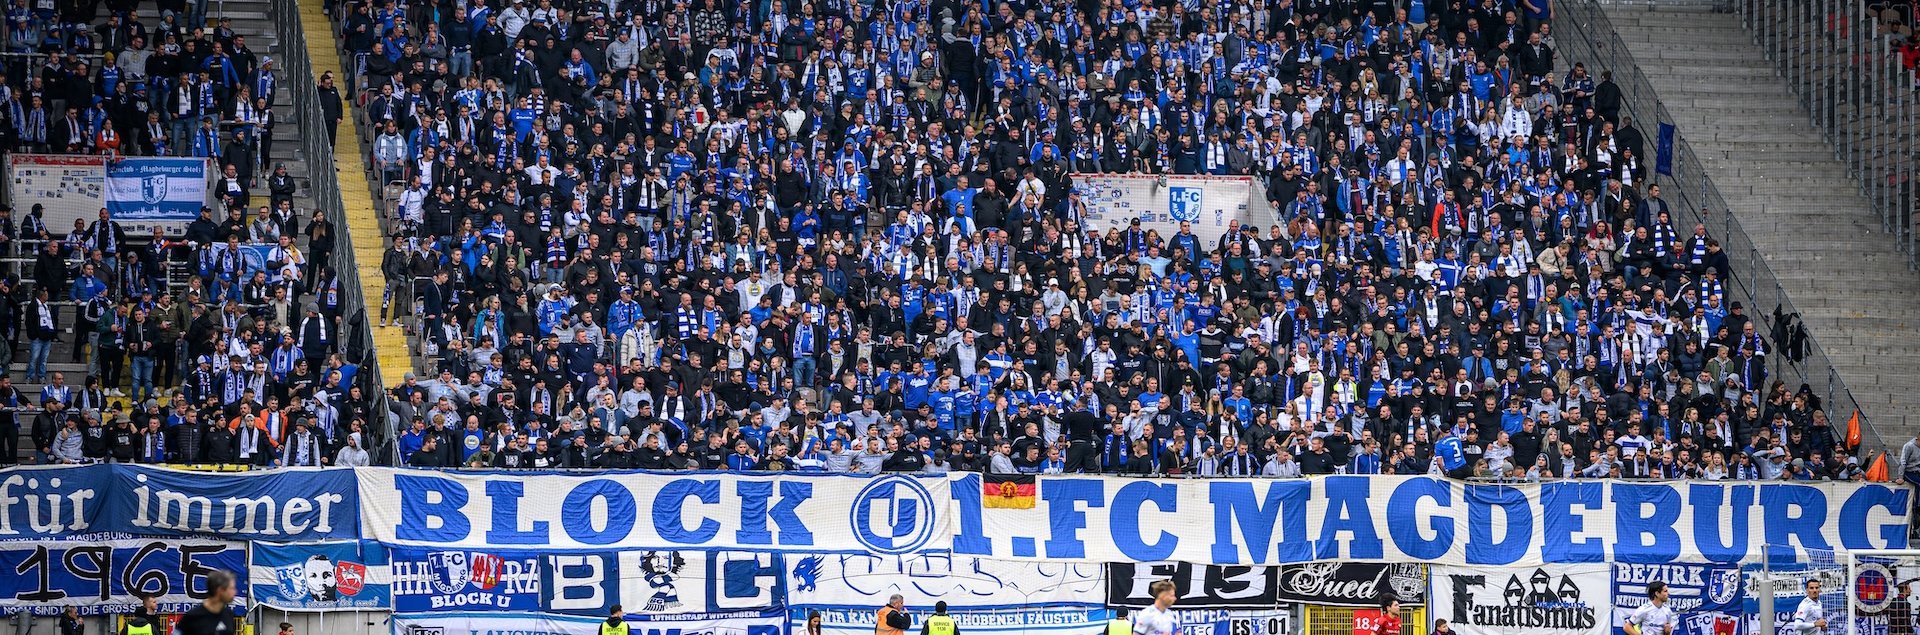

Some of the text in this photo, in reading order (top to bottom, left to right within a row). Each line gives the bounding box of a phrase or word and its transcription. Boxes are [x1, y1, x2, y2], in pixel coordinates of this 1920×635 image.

[1171, 191, 1200, 202] 1.FC
[0, 474, 342, 536] für immer
[395, 474, 814, 546] BLOCK
[951, 473, 1910, 565] 1.FC MAGDEBURG
[432, 569, 467, 594] MAGDEBURG
[1616, 563, 1705, 587] BEZIRK
[35, 606, 59, 615] SIND
[82, 605, 99, 615] DIE
[161, 602, 182, 613] AUF
[431, 592, 512, 608] BLOCK U
[1449, 574, 1596, 631] Fanatismus
[650, 612, 708, 622] LUTHERSTADT
[1028, 610, 1089, 625] FÄUSTEN
[1232, 619, 1250, 635] ES
[1268, 618, 1286, 635] 01
